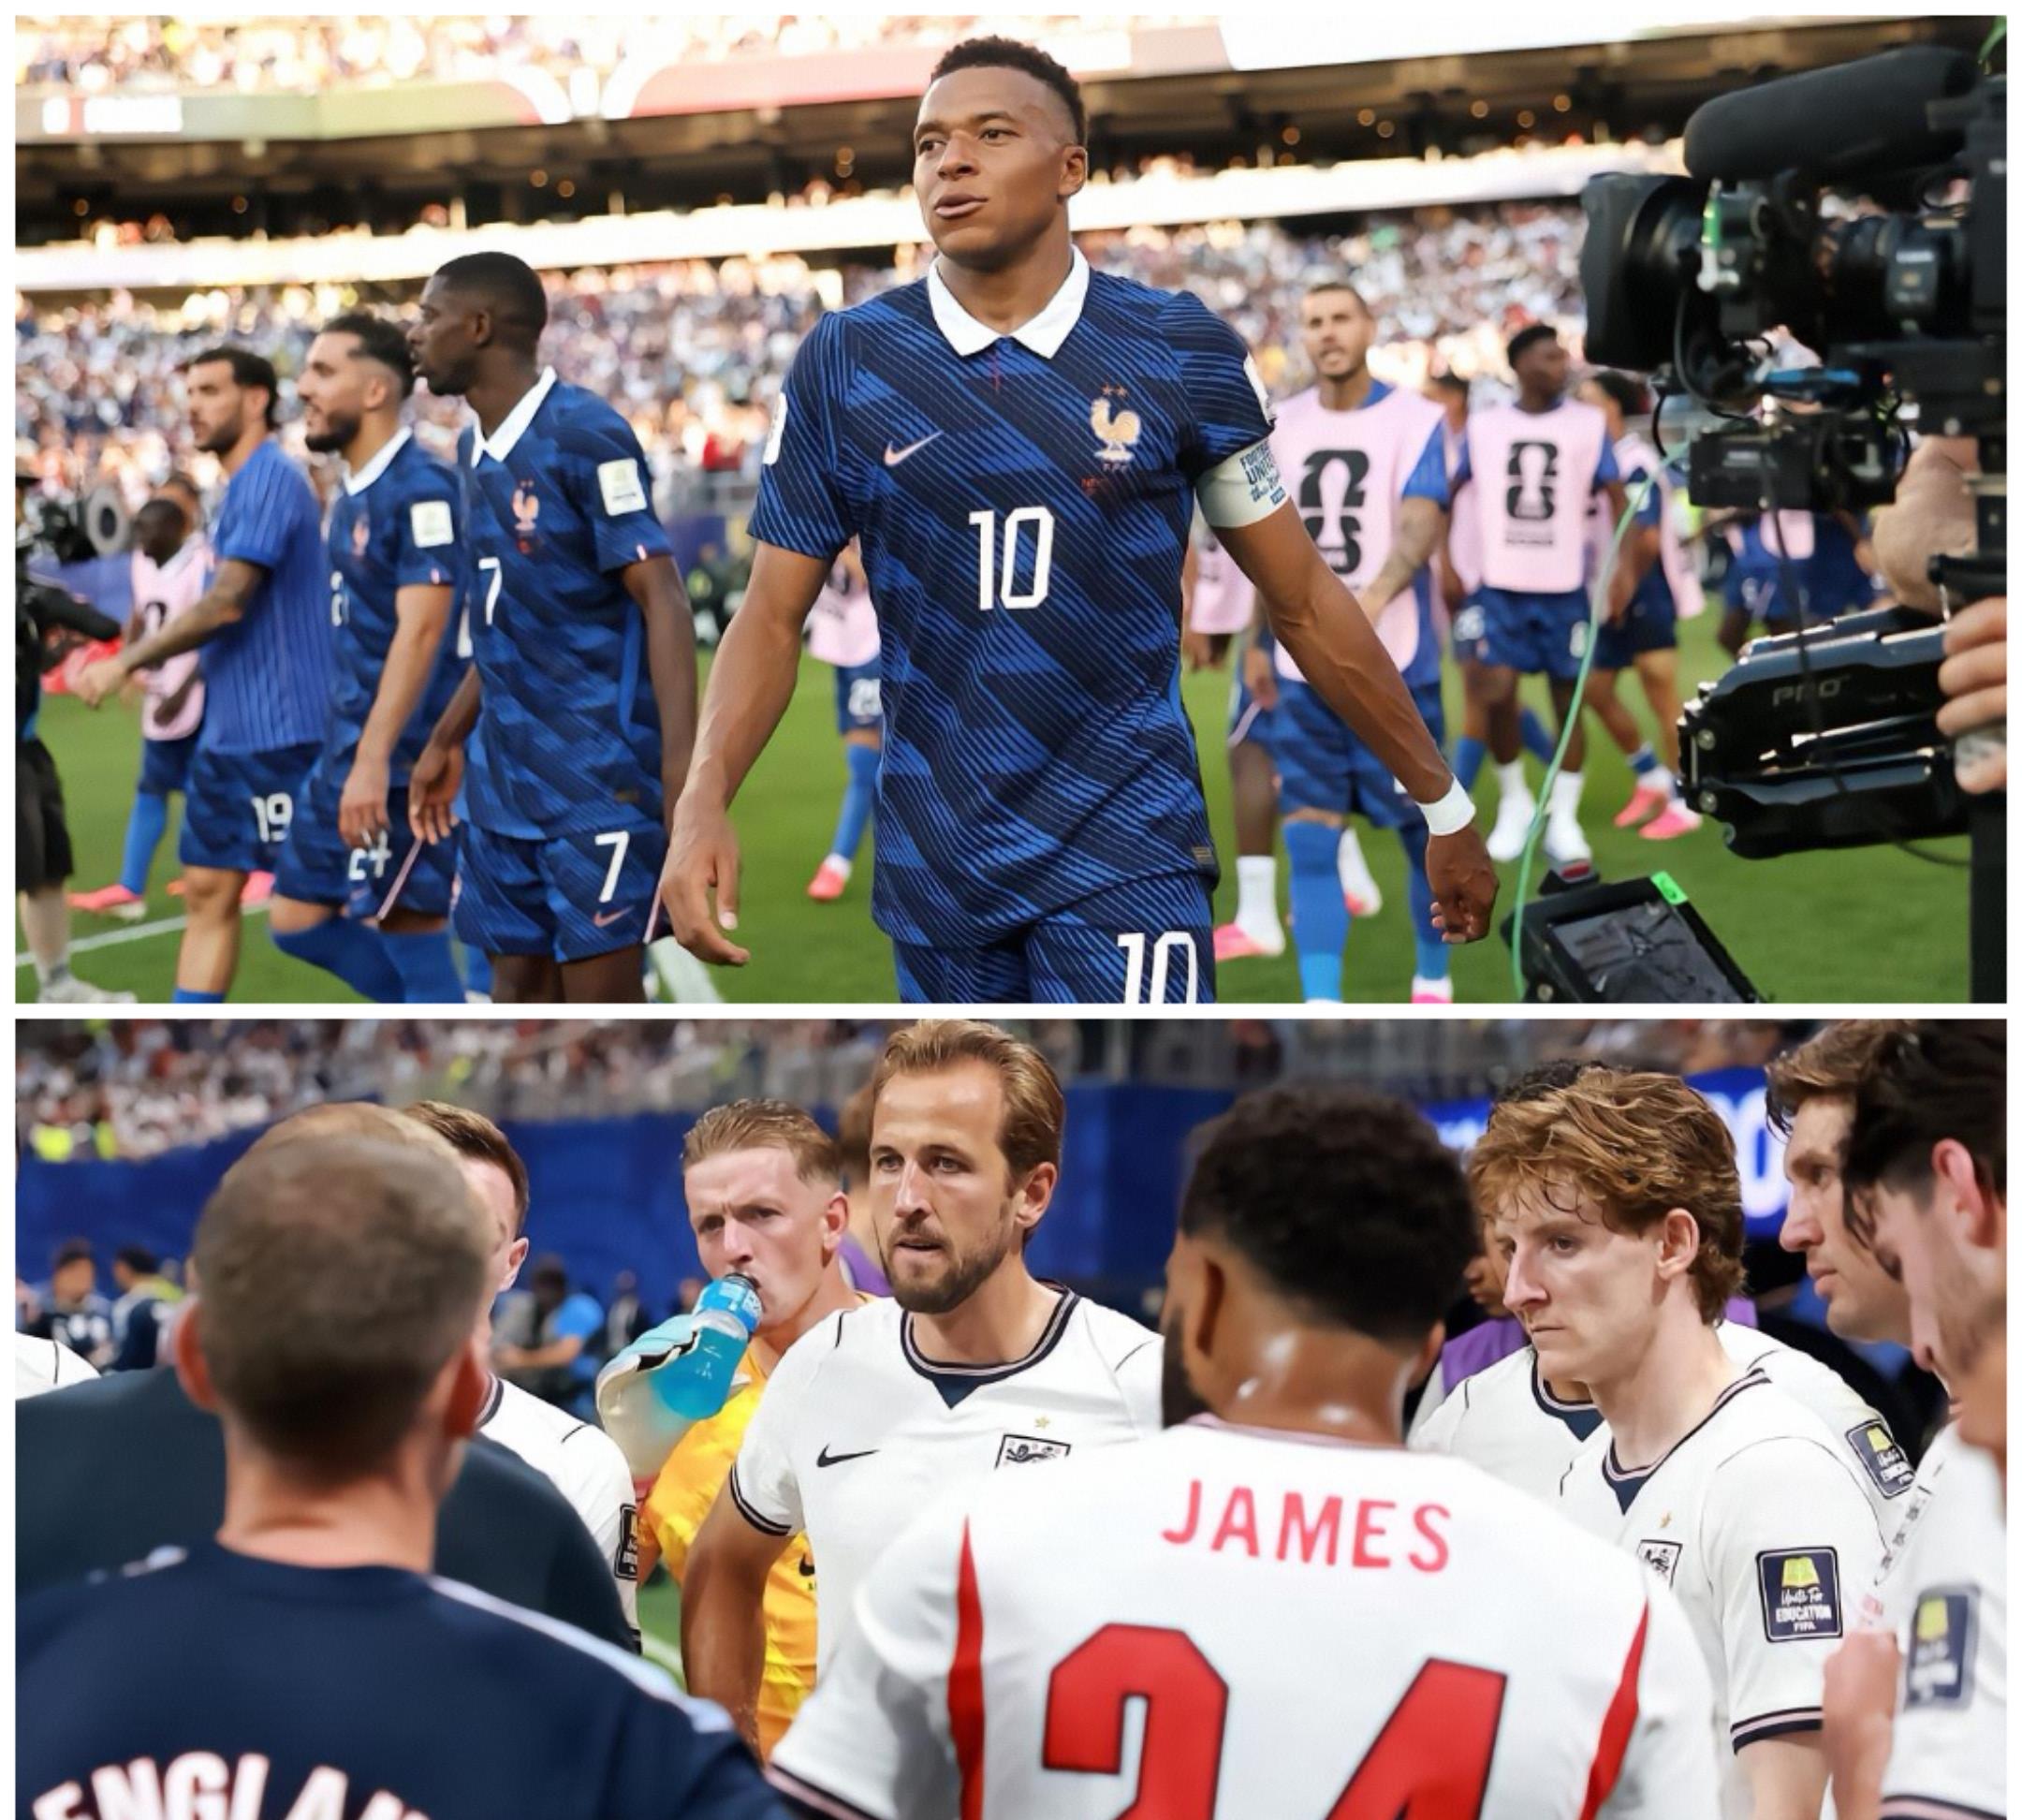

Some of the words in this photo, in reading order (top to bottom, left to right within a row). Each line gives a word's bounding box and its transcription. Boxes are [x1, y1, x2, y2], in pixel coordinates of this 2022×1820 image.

[478, 557, 503, 625] 7
[969, 506, 1055, 611] 10
[251, 793, 293, 843] 19
[594, 830, 630, 903] 7
[1117, 931, 1198, 1005] 10
[1161, 1478, 1452, 1574] JAMES
[1042, 1622, 1509, 1820] 24
